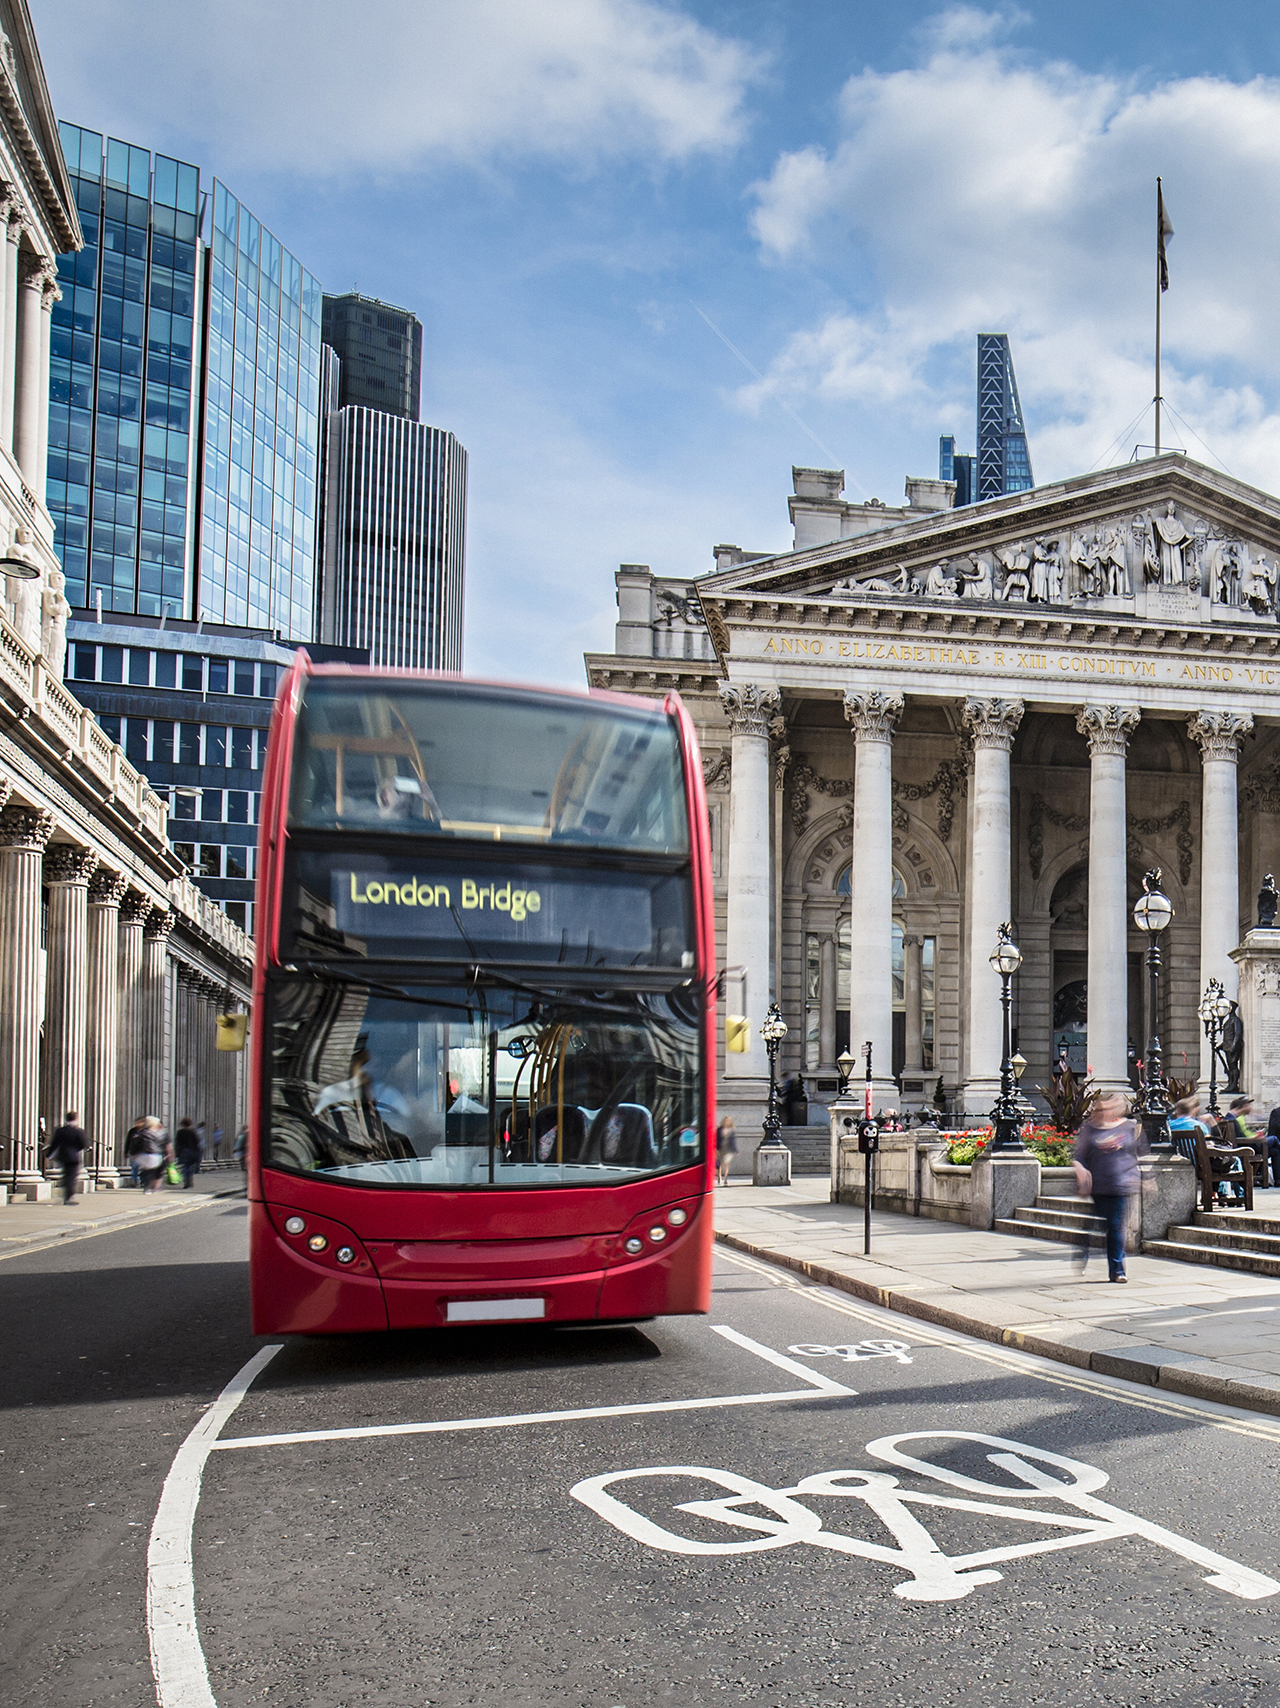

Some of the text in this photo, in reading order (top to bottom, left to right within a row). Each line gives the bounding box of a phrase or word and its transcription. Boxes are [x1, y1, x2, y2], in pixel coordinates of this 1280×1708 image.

[763, 637, 824, 655] ANNO
[839, 642, 980, 664] ELIZABETHAE
[994, 652, 1006, 667] R
[1017, 653, 1048, 670] XIII
[1058, 656, 1156, 677] CONDITVM
[1179, 664, 1233, 682] ANNO
[350, 872, 541, 922] London Bridge
